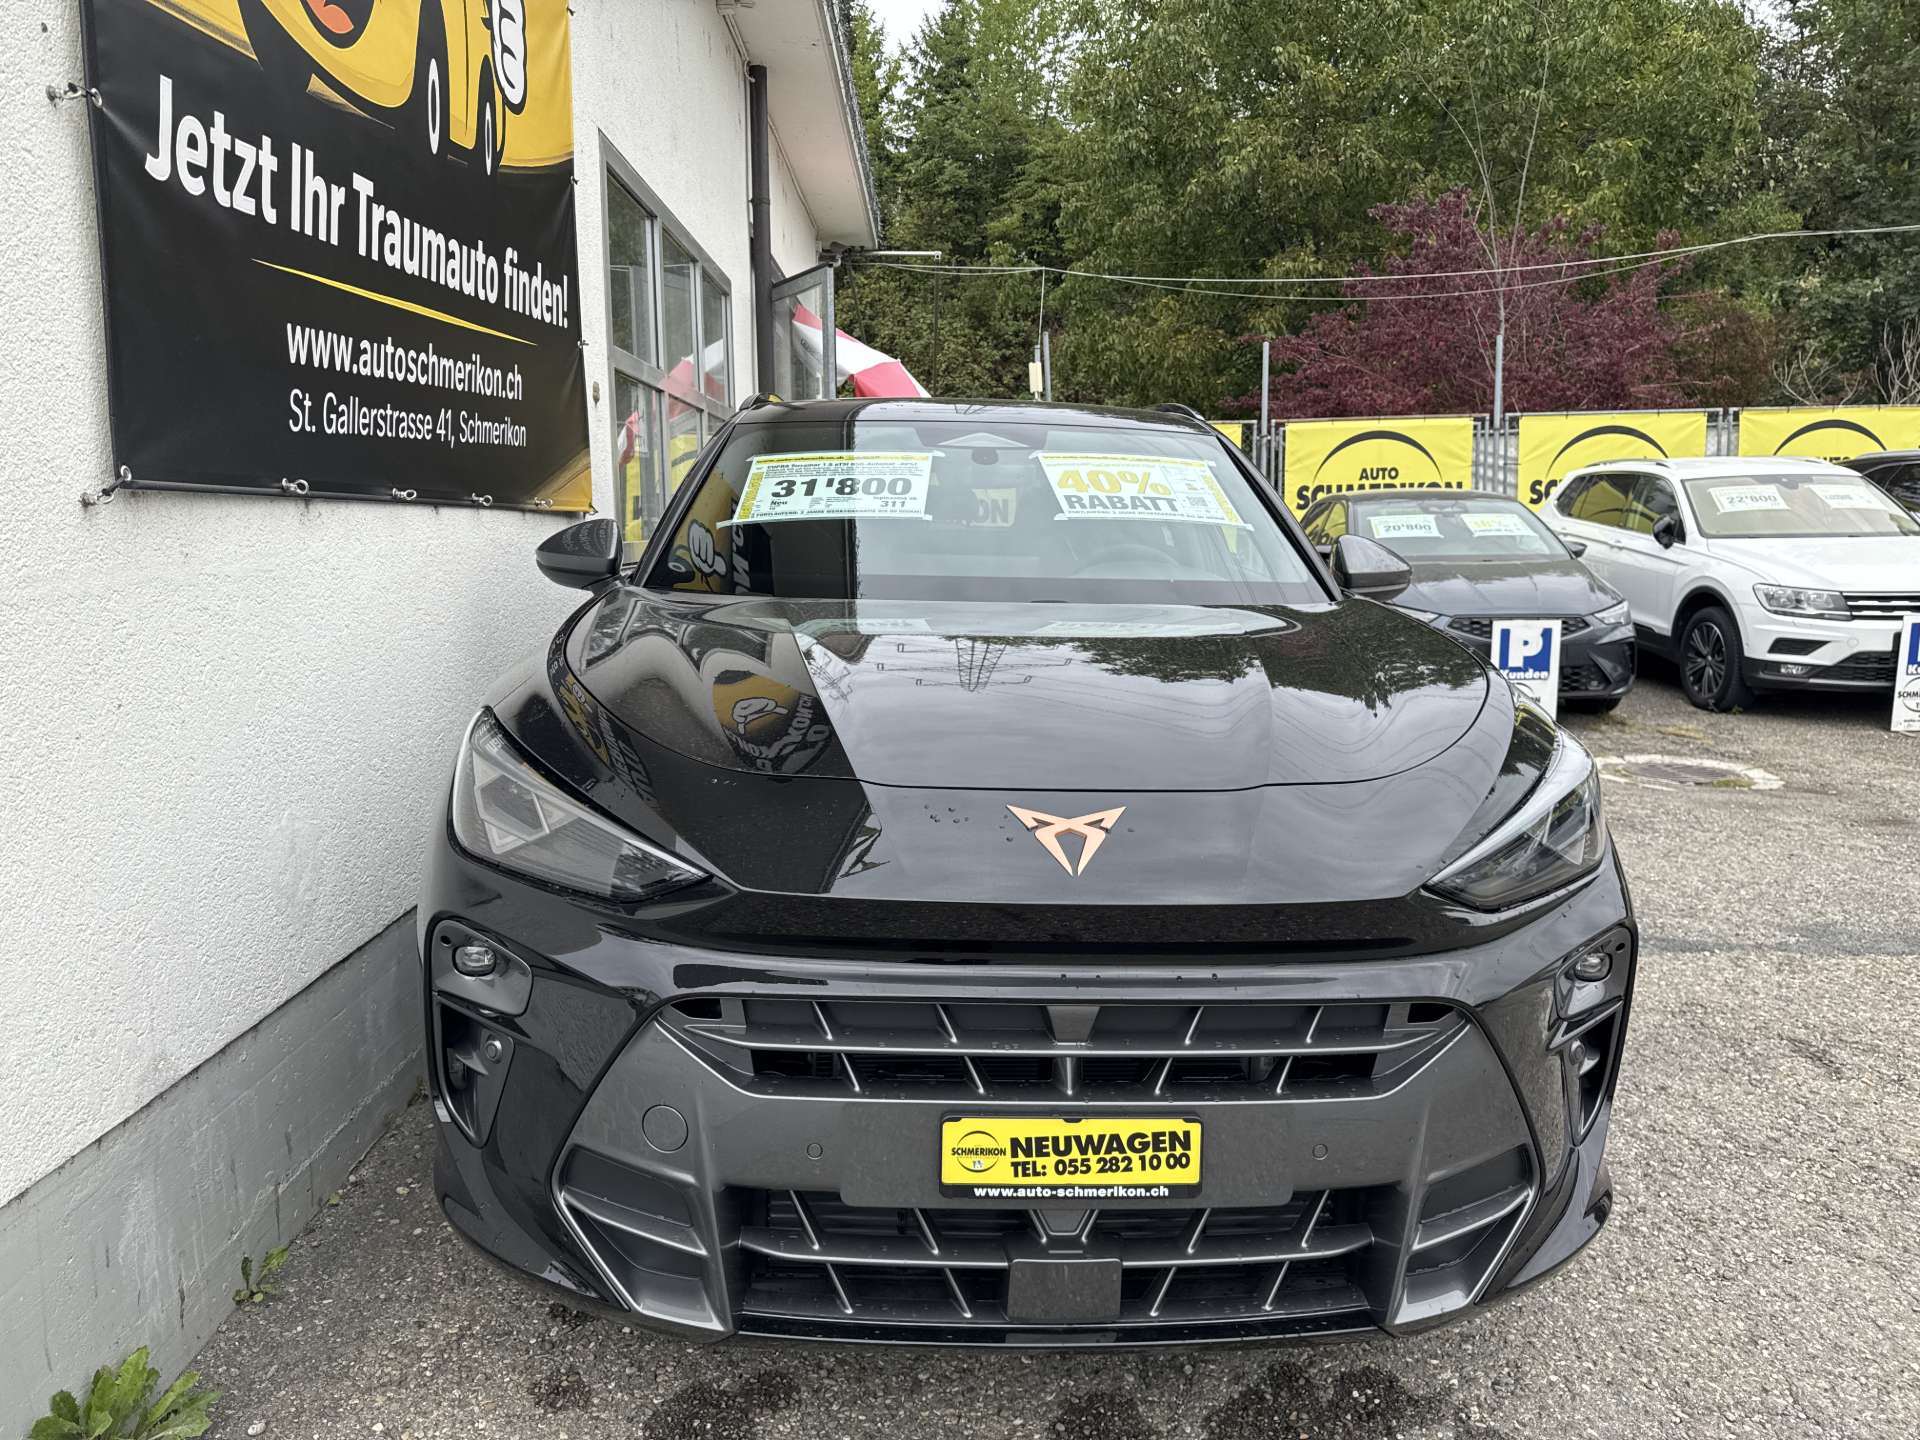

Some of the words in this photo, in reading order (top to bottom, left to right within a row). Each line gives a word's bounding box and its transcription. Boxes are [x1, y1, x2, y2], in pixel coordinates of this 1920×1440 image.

[145, 74, 278, 224] Jetzt
[291, 142, 345, 246] Ihr
[352, 172, 499, 304] Traumauto
[503, 246, 569, 328] finden!
[287, 322, 523, 401] www.autoschmerikon.ch
[289, 388, 317, 434] St.
[323, 392, 433, 441] Gallerstrasse
[436, 407, 455, 449] 41,
[459, 410, 527, 447] Schmerikon
[1057, 469, 1172, 496] 40%
[1359, 467, 1399, 480] AUTO
[771, 477, 912, 498] 31'800
[1063, 495, 1178, 511] RABATT
[1500, 668, 1549, 680] Kunden
[951, 1147, 1006, 1156] SCHMERIKON
[1010, 1131, 1191, 1159] NEUWAGEN
[1010, 1161, 1047, 1178] TEL:
[1054, 1158, 1091, 1176] 055
[1096, 1156, 1133, 1174] 282
[1138, 1154, 1162, 1171] 10
[1165, 1153, 1190, 1170] 00
[974, 1186, 1168, 1198] www.auto-schmerikon.ch
